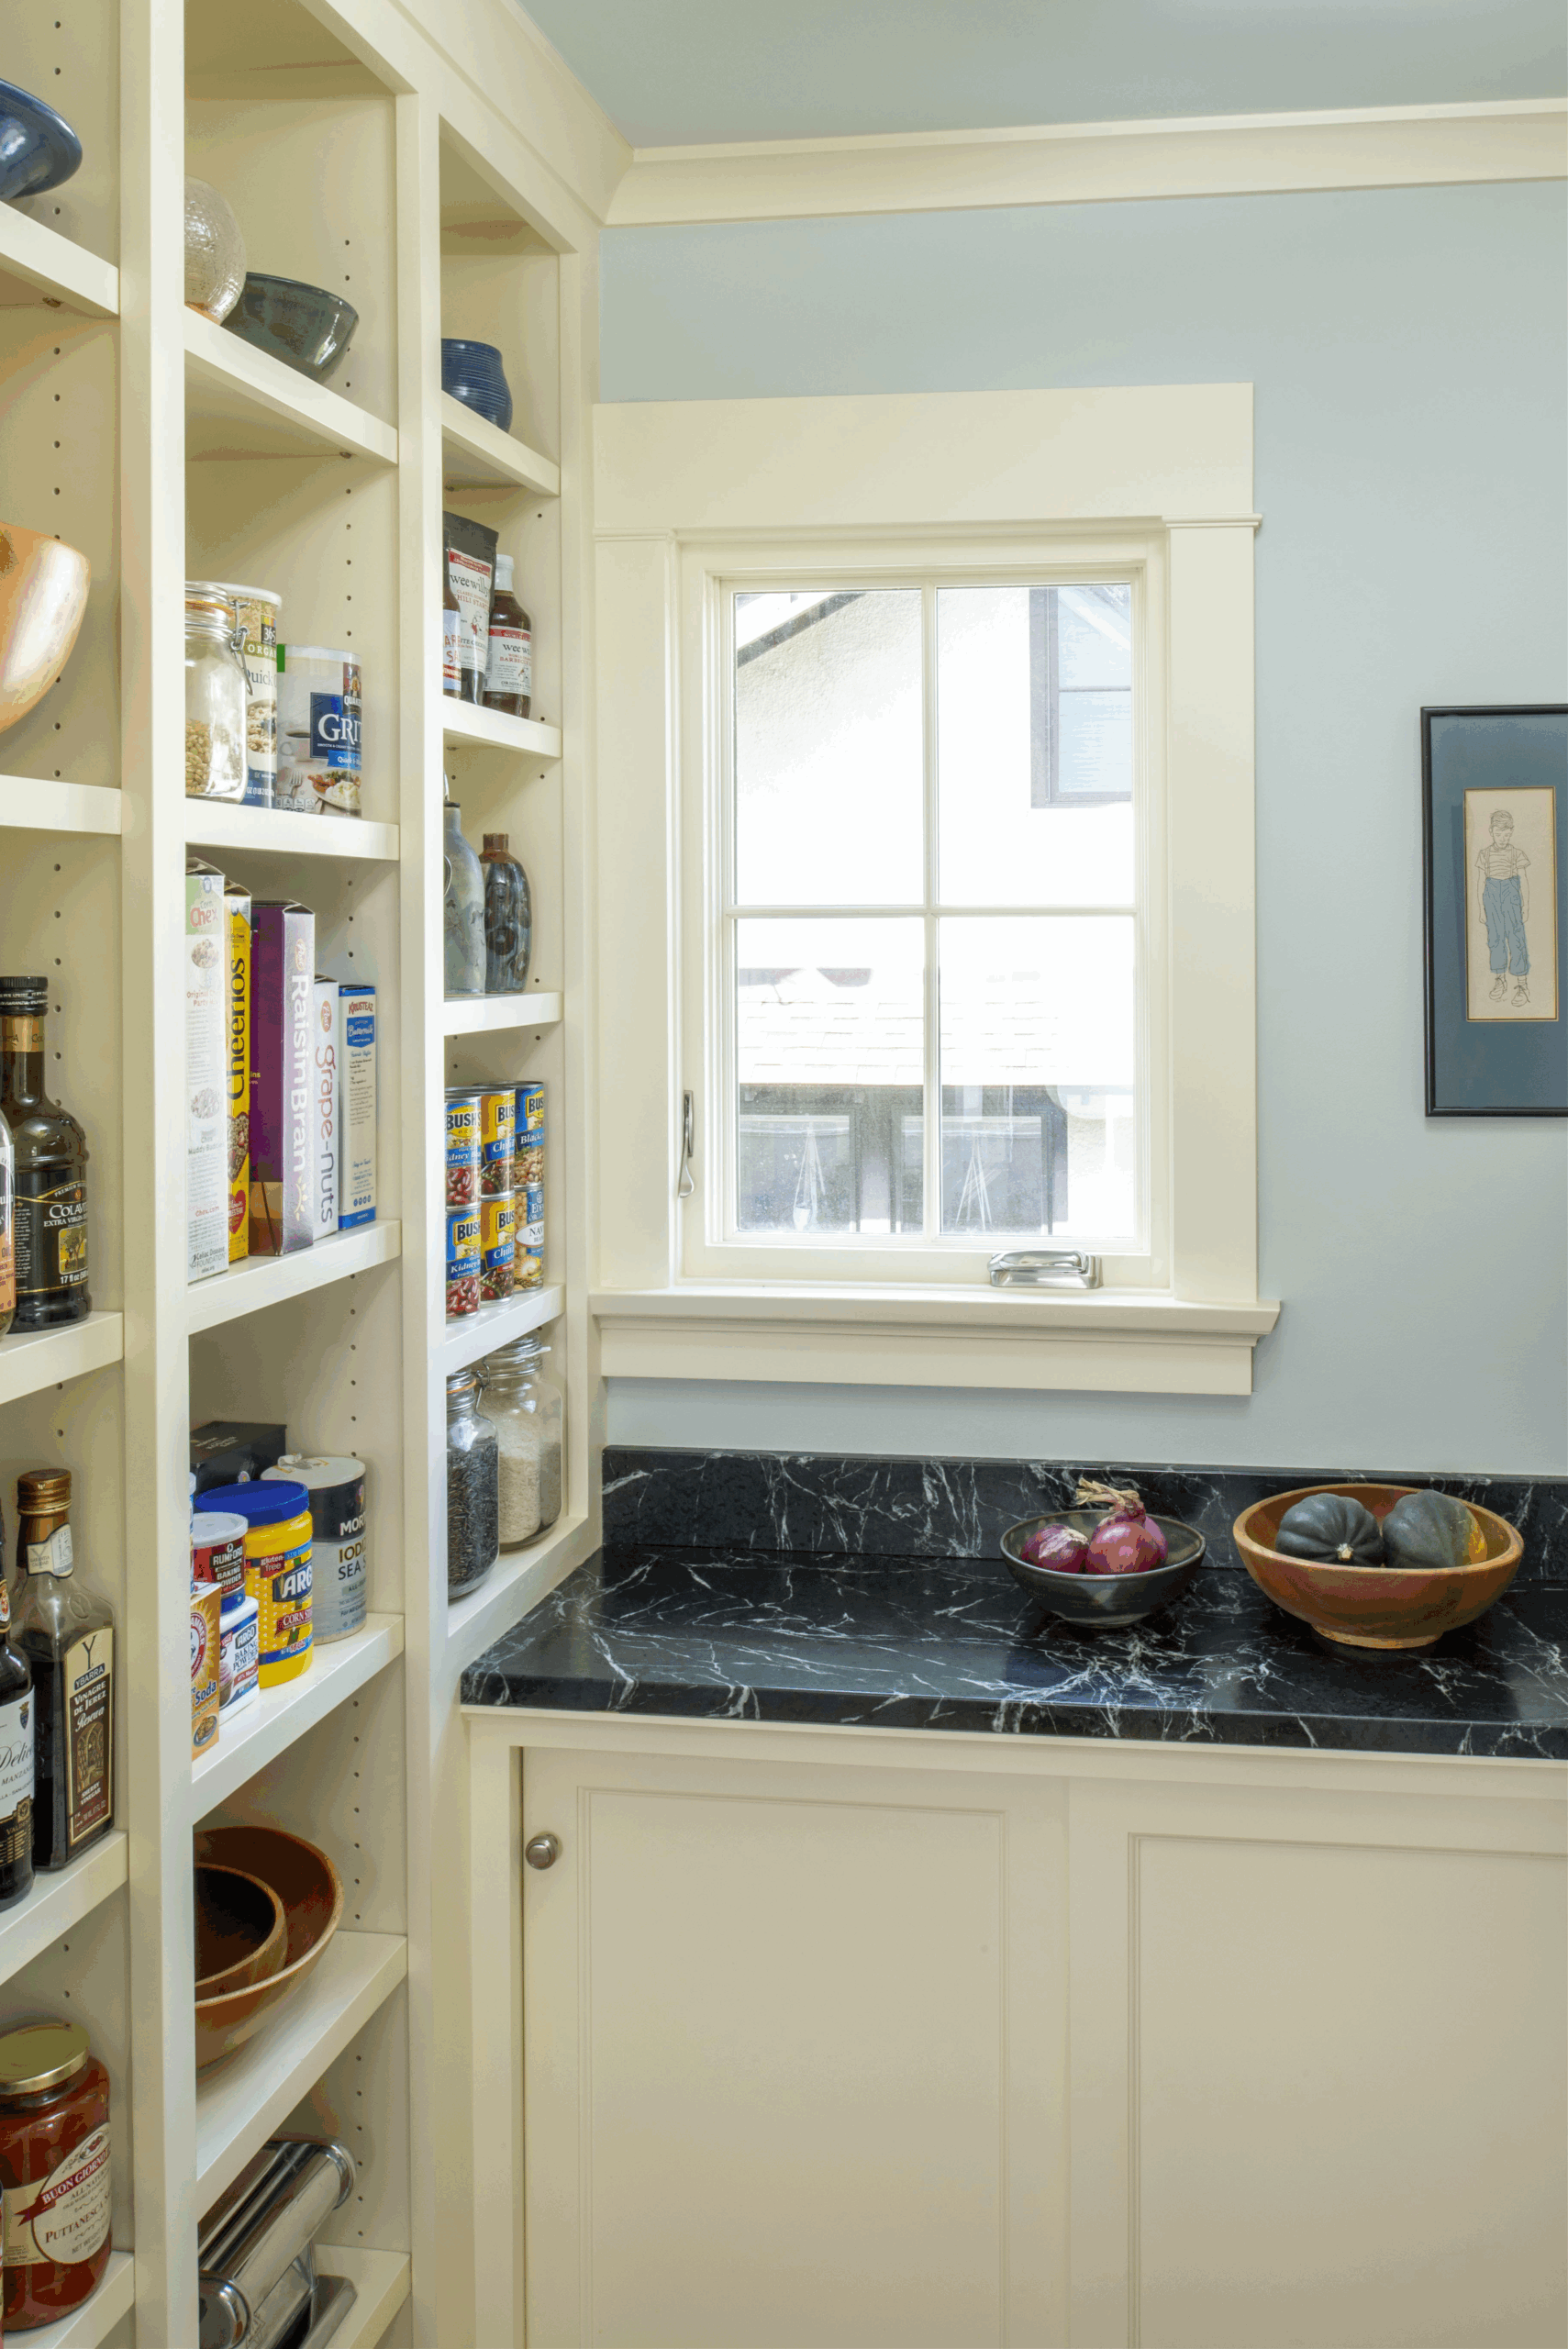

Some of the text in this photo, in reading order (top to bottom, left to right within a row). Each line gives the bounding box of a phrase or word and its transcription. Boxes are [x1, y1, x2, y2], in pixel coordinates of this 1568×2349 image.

[455, 595, 472, 604] HILI
[226, 958, 246, 1100] Cheerios
[291, 974, 310, 1173] Raisin Bran
[315, 1044, 336, 1223] grape-nuts
[447, 1152, 469, 1163] idney
[43, 1219, 67, 1228] EXTRA
[217, 1564, 241, 1581] BAKING
[265, 1562, 282, 1572] free
[338, 1560, 361, 1580] SEA
[220, 1572, 242, 1587] OWDER
[283, 1610, 305, 1627] CORN
[75, 1664, 105, 1688] YBARRA
[73, 1680, 106, 1706] VINAGRE
[85, 1689, 107, 1710] JEREZ
[195, 1680, 217, 1707] Soda
[41, 2176, 74, 2206] BUON
[70, 2187, 84, 2201] ALL
